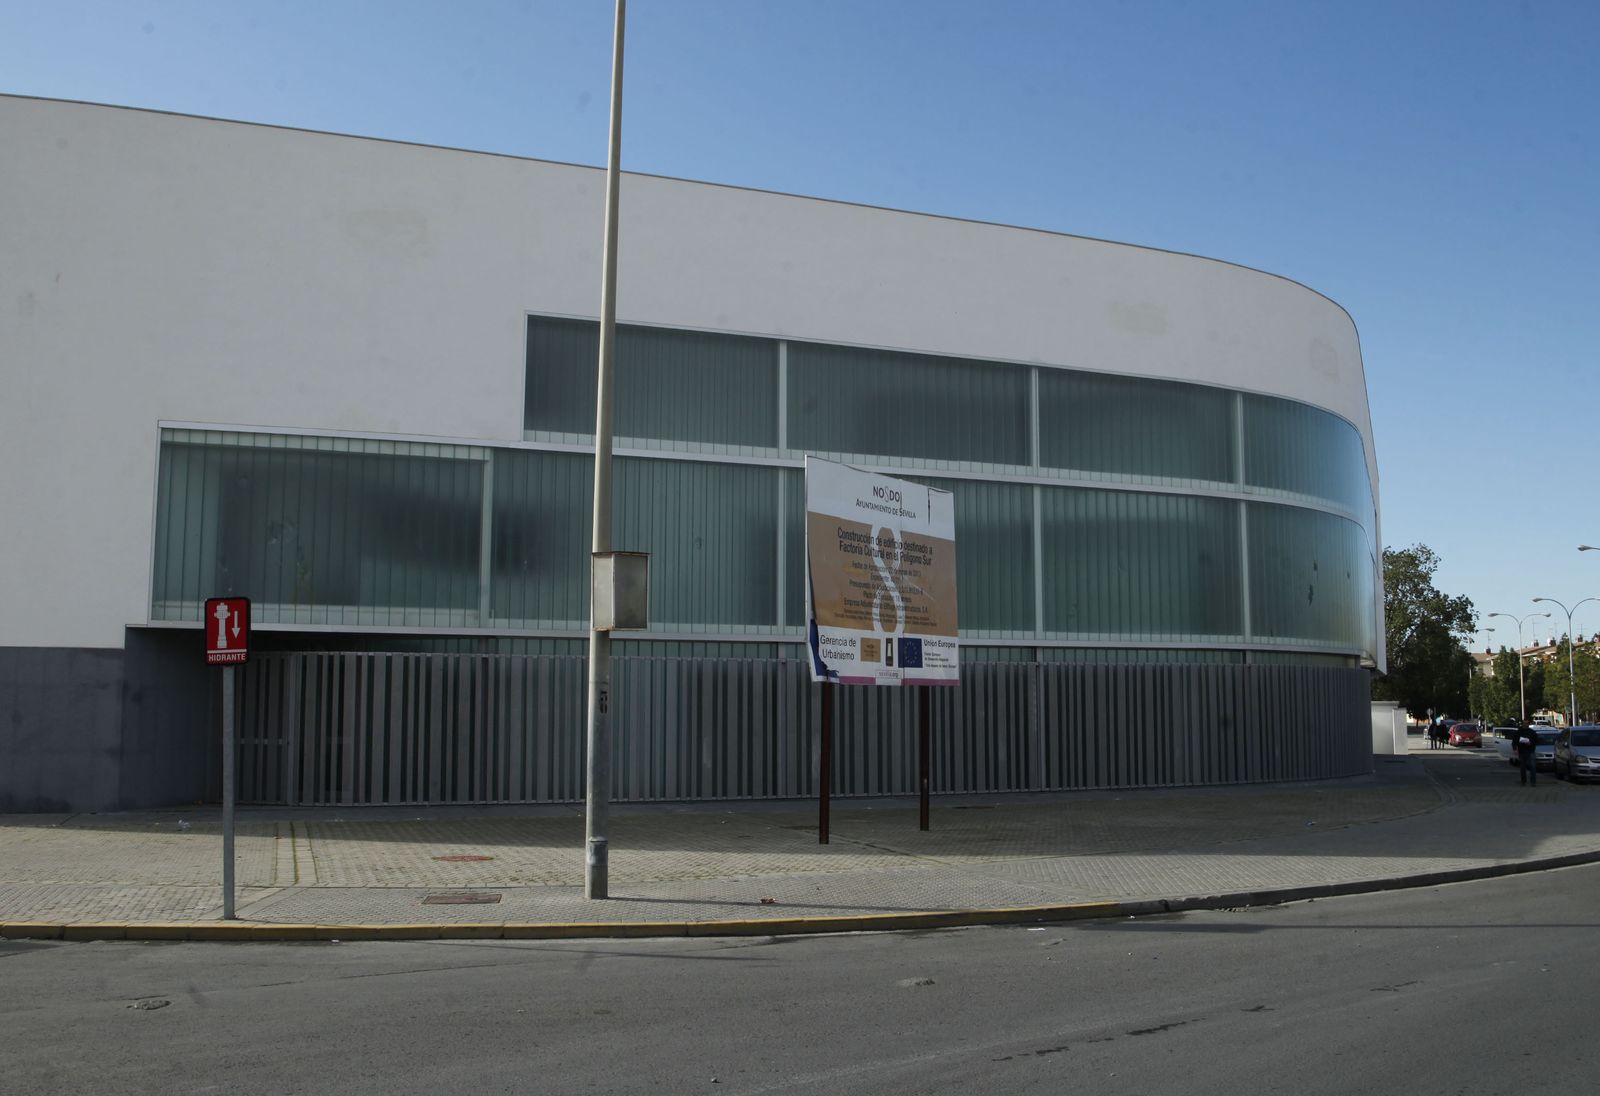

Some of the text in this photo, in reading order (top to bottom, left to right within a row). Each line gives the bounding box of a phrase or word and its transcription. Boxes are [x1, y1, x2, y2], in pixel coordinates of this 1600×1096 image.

[892, 507, 898, 516] DE
[899, 507, 917, 519] SEVILLA
[875, 535, 882, 546] de
[885, 551, 892, 560] en
[893, 551, 899, 561] el
[819, 634, 857, 648] Gerencia de
[938, 639, 956, 649] Europea
[208, 653, 247, 662] HIDRANTE
[822, 649, 855, 662] Urbanismo
